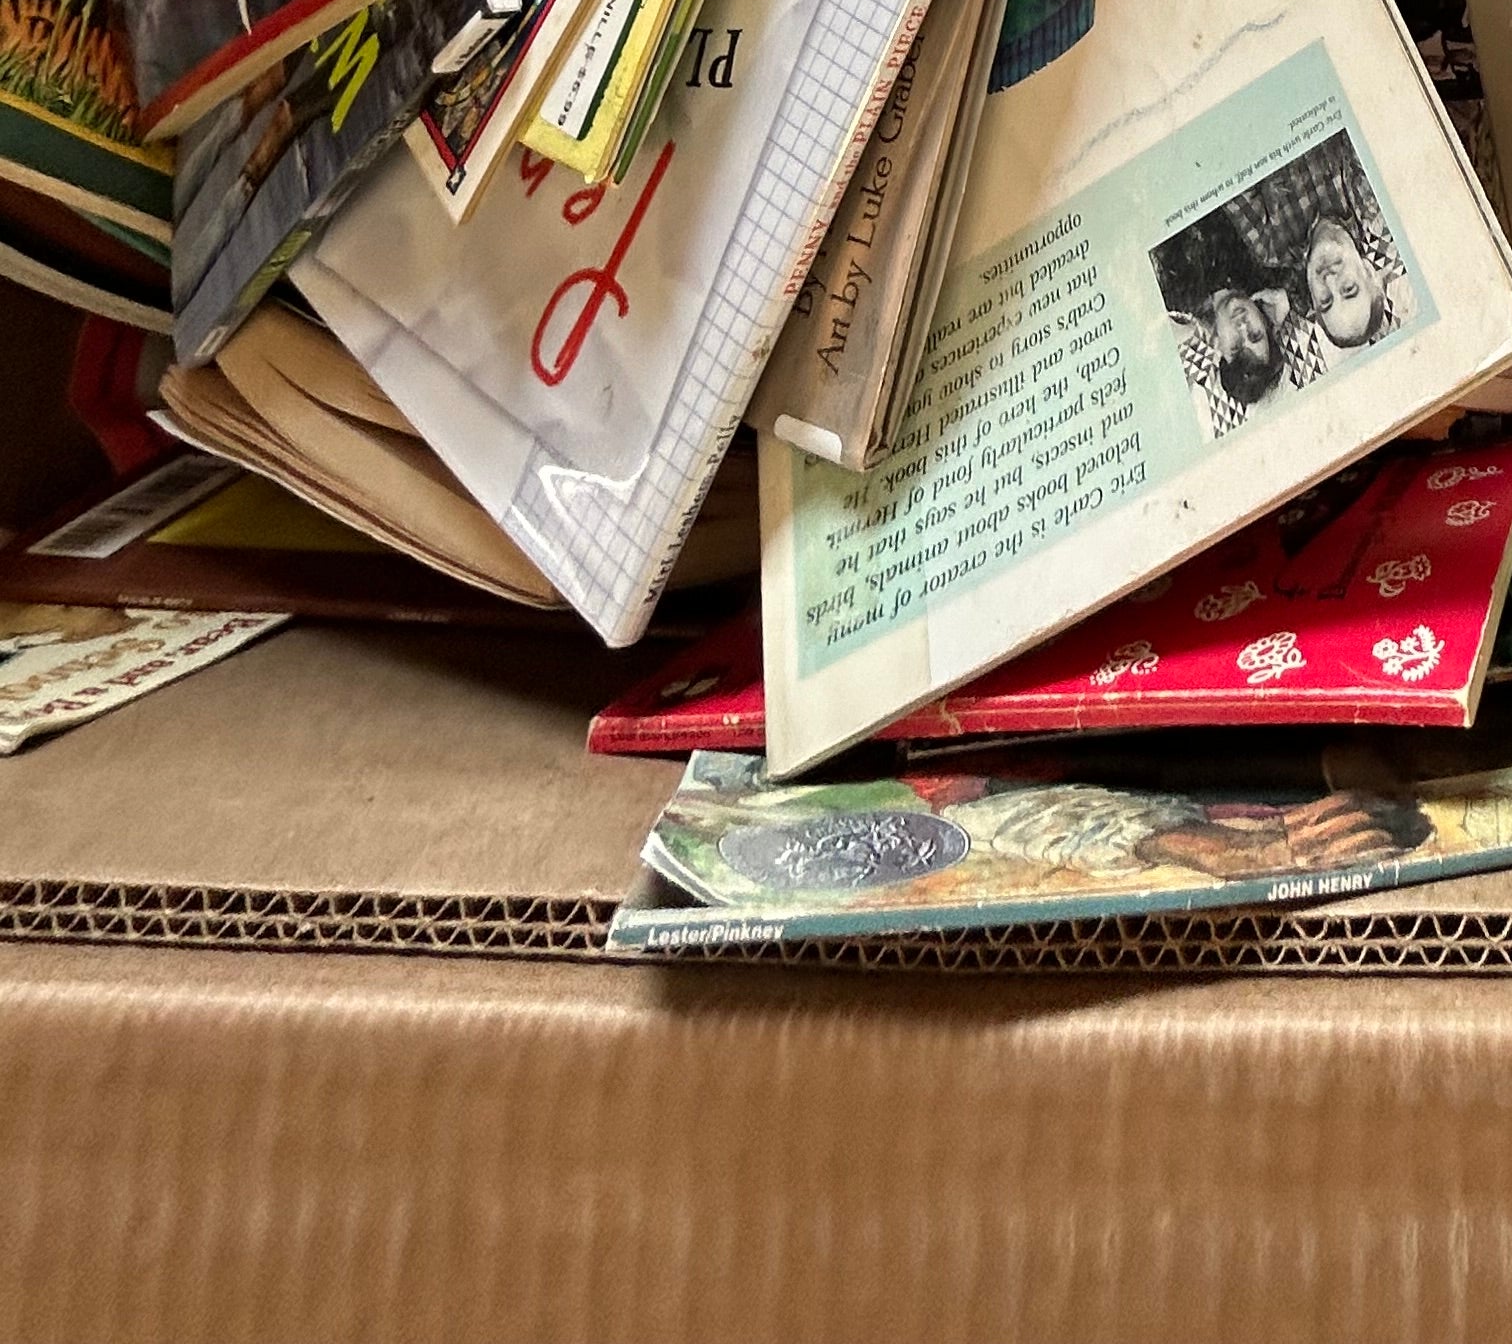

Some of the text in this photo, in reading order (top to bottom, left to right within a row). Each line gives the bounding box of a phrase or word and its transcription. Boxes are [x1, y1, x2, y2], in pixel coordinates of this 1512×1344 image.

[781, 218, 829, 294] PENNY
[852, 79, 890, 148] PLAIN
[886, 7, 925, 71] PIECE
[818, 153, 899, 374] Art by Luke
[1009, 322, 1050, 357] story
[1069, 318, 1112, 354] wrote
[1032, 347, 1065, 380] and
[938, 371, 1025, 434] illustrated
[1041, 376, 1070, 401] the
[1089, 367, 1130, 407] feels
[968, 419, 994, 447] of
[981, 392, 1084, 468] particularly
[934, 434, 968, 463] this
[914, 402, 1134, 534] and but he says
[932, 458, 973, 494] fond
[957, 431, 1140, 546] beloved books about
[886, 460, 1148, 619] Eric Carle is the creator of
[1266, 872, 1373, 901] JOHN HENRY
[647, 924, 784, 946] Lester/Pinkney
